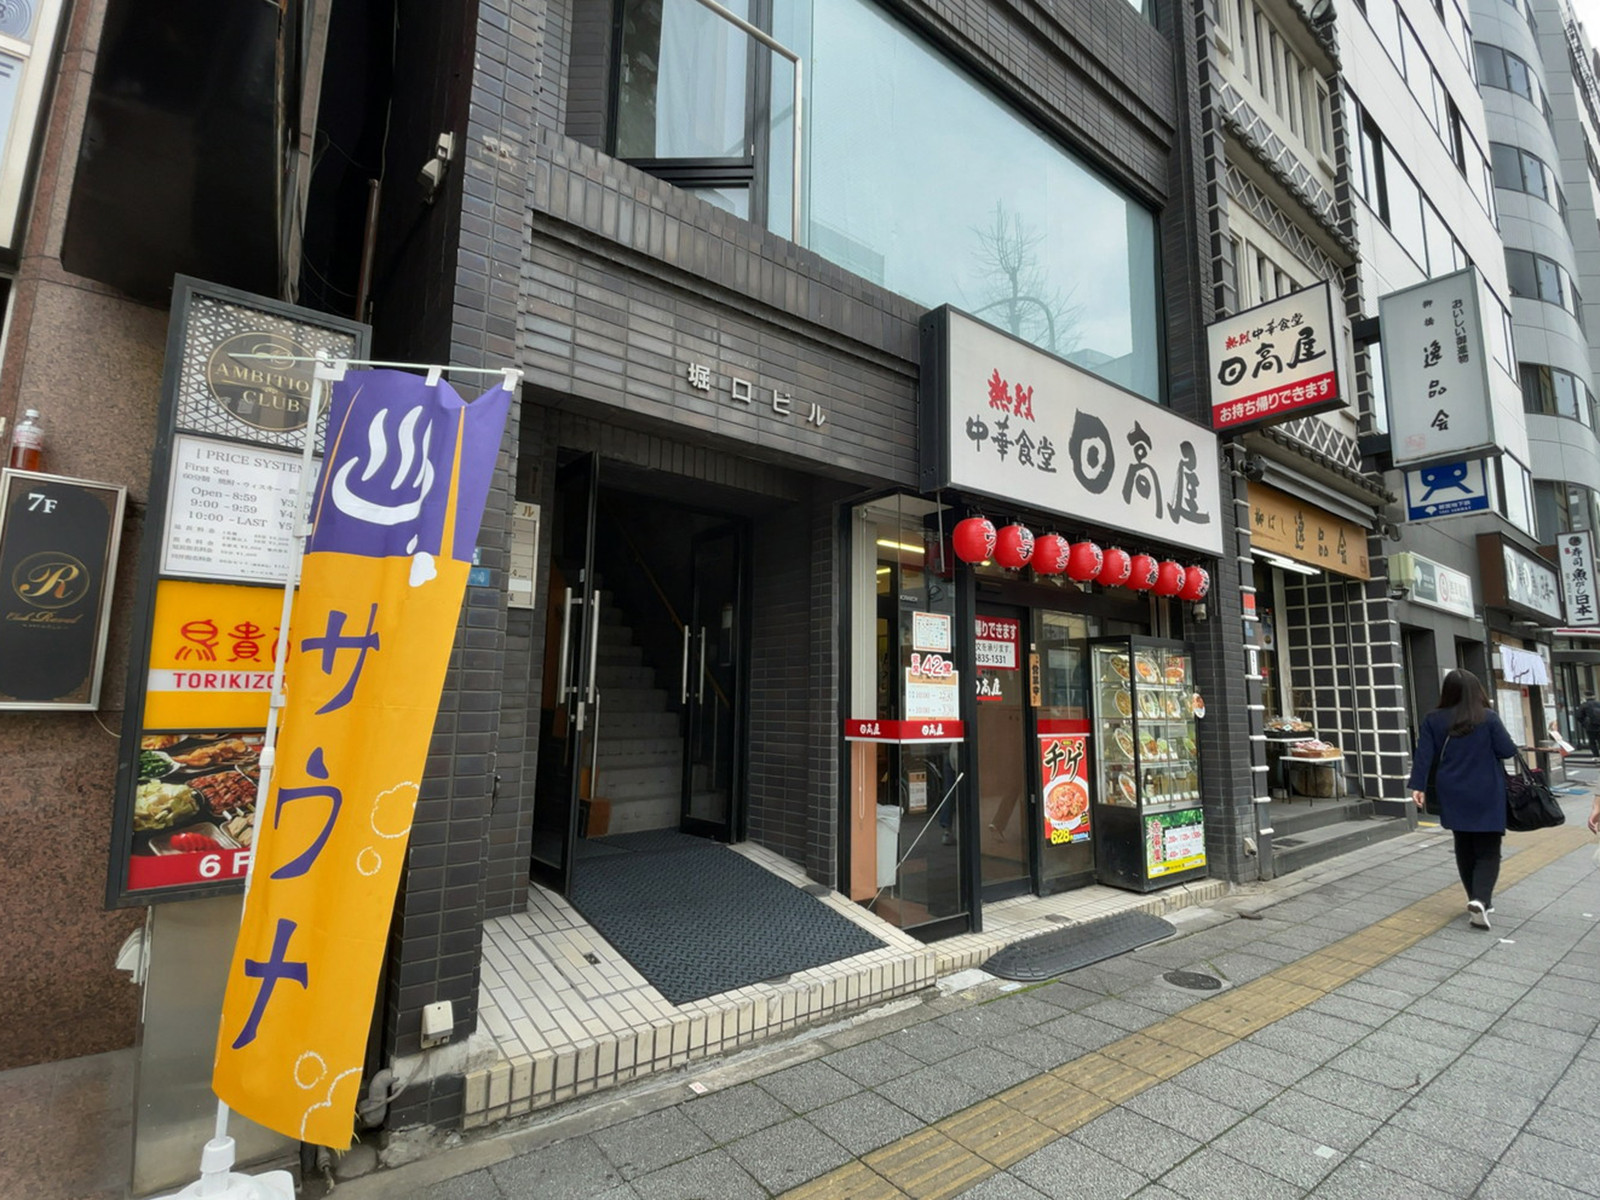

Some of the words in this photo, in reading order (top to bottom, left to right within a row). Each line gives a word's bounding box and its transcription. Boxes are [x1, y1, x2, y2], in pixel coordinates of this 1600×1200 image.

[1217, 326, 1327, 387] 日高屋
[215, 362, 310, 393] AMBITIO
[242, 390, 300, 413] CLUB
[687, 362, 826, 428] 堀口ビル
[987, 367, 1036, 423] 熱烈
[1219, 377, 1332, 423] お持ち帰りできます
[965, 413, 1058, 474] 中華食堂
[184, 462, 209, 473] First
[212, 466, 230, 476] Set
[206, 449, 250, 466] PRICE
[1068, 407, 1211, 525] 日高屋
[27, 492, 58, 514] 7F
[190, 498, 219, 509] 9:00
[231, 503, 258, 514] 9:59
[191, 486, 223, 498] Open
[232, 492, 258, 503] 8:59
[188, 510, 224, 523] 10:00
[236, 516, 268, 528] LAST
[976, 653, 1007, 664] 835-1531
[172, 671, 287, 690] TORIKIZO
[922, 724, 944, 736] 日高屋
[1044, 741, 1083, 783] チゲ
[230, 602, 380, 1050] サウナ
